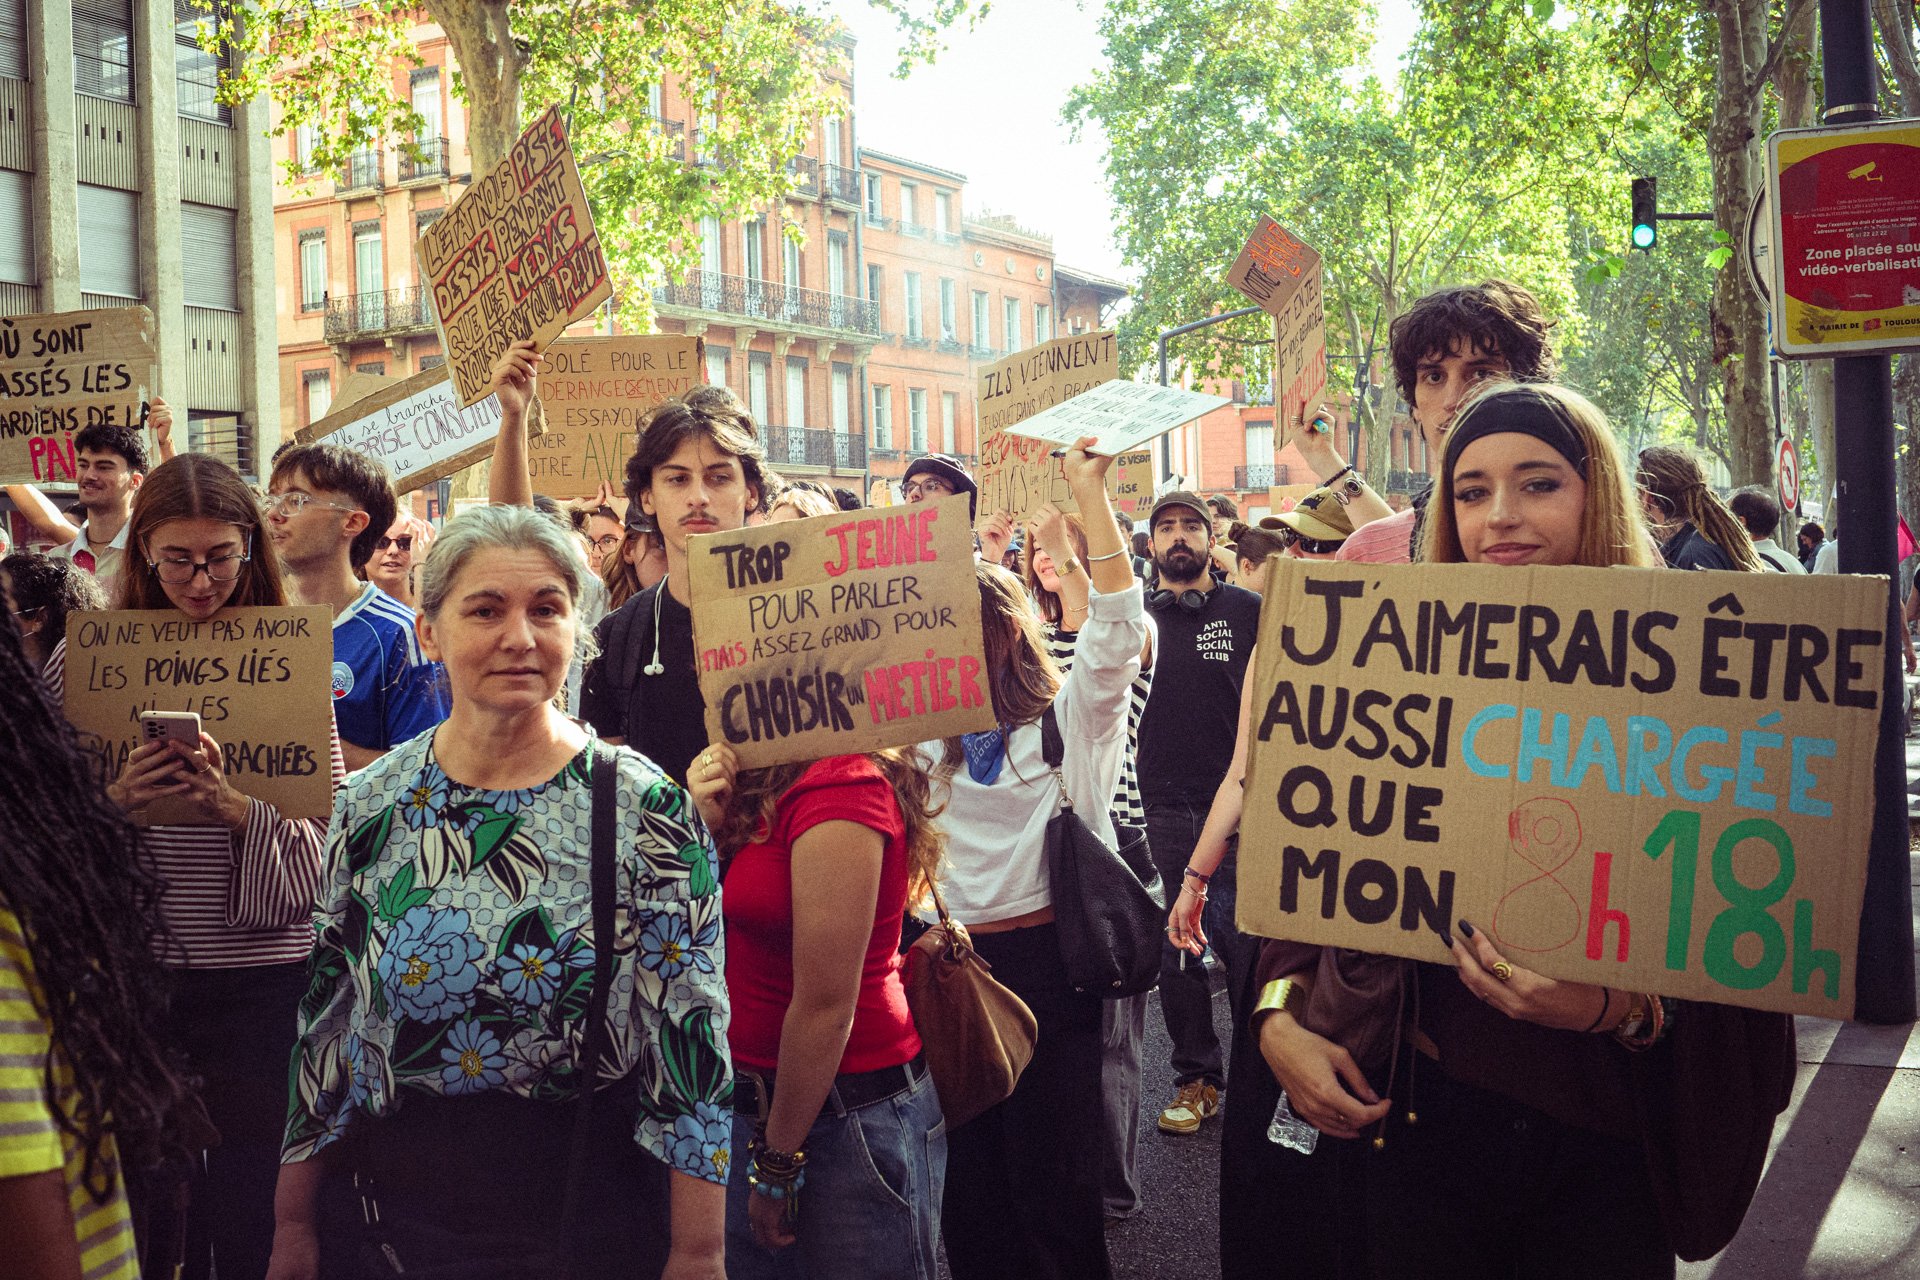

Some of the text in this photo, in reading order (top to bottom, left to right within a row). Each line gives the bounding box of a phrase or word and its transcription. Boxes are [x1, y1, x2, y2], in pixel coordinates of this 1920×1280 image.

[474, 160, 516, 229] NOUS
[435, 160, 566, 322] DESSUS PENDANT
[1805, 242, 1920, 261] Zone placée sou
[1799, 256, 1920, 277] vidéo-verbalisati
[448, 304, 484, 360] QUE
[480, 277, 510, 331] LES
[455, 333, 500, 400] NOUS
[558, 234, 603, 313] PLEUT
[1279, 307, 1290, 342] EST
[1294, 287, 1304, 320] EN
[1819, 323, 1847, 331] MAIRIE
[1885, 318, 1920, 327] TOULOUS
[32, 323, 92, 358] SONT
[537, 348, 688, 374] SOLÉ POUR LE
[1281, 347, 1288, 369] ET
[1288, 331, 1299, 358] VOUS
[1295, 346, 1304, 375] LES
[0, 357, 132, 398] ASSÉS LES
[983, 333, 1114, 401] ILS VIENNENT
[0, 405, 79, 440] ARDIENS
[87, 405, 115, 428] DE
[361, 420, 380, 437] se
[386, 393, 447, 426] branche
[28, 432, 78, 482] PAI
[395, 459, 414, 475] de
[529, 432, 638, 482] OTRE AVE
[709, 506, 939, 590] TROP JEUNE
[749, 575, 922, 634] POUR PARLER
[1203, 620, 1228, 632] ANTI
[78, 615, 311, 648] ON NE VEUT PAS AVOIR
[703, 607, 957, 672] MAIS ASSEZ GRAND POUR
[1196, 629, 1233, 642] SOCIAL
[1196, 640, 1234, 651] SOCIAL
[1281, 576, 1884, 711] J'AIMERAIS ÊTRE
[88, 647, 291, 692] LES POINGS LIÉS
[1203, 652, 1230, 662] CLUB
[720, 648, 986, 745] CHOISIR UN METIER
[220, 741, 318, 778] RACHÉES
[1258, 680, 1838, 819] AUSSI CHARGÉE
[1277, 764, 1444, 845] QUE
[1279, 797, 1843, 1000] MON 8h 18h
